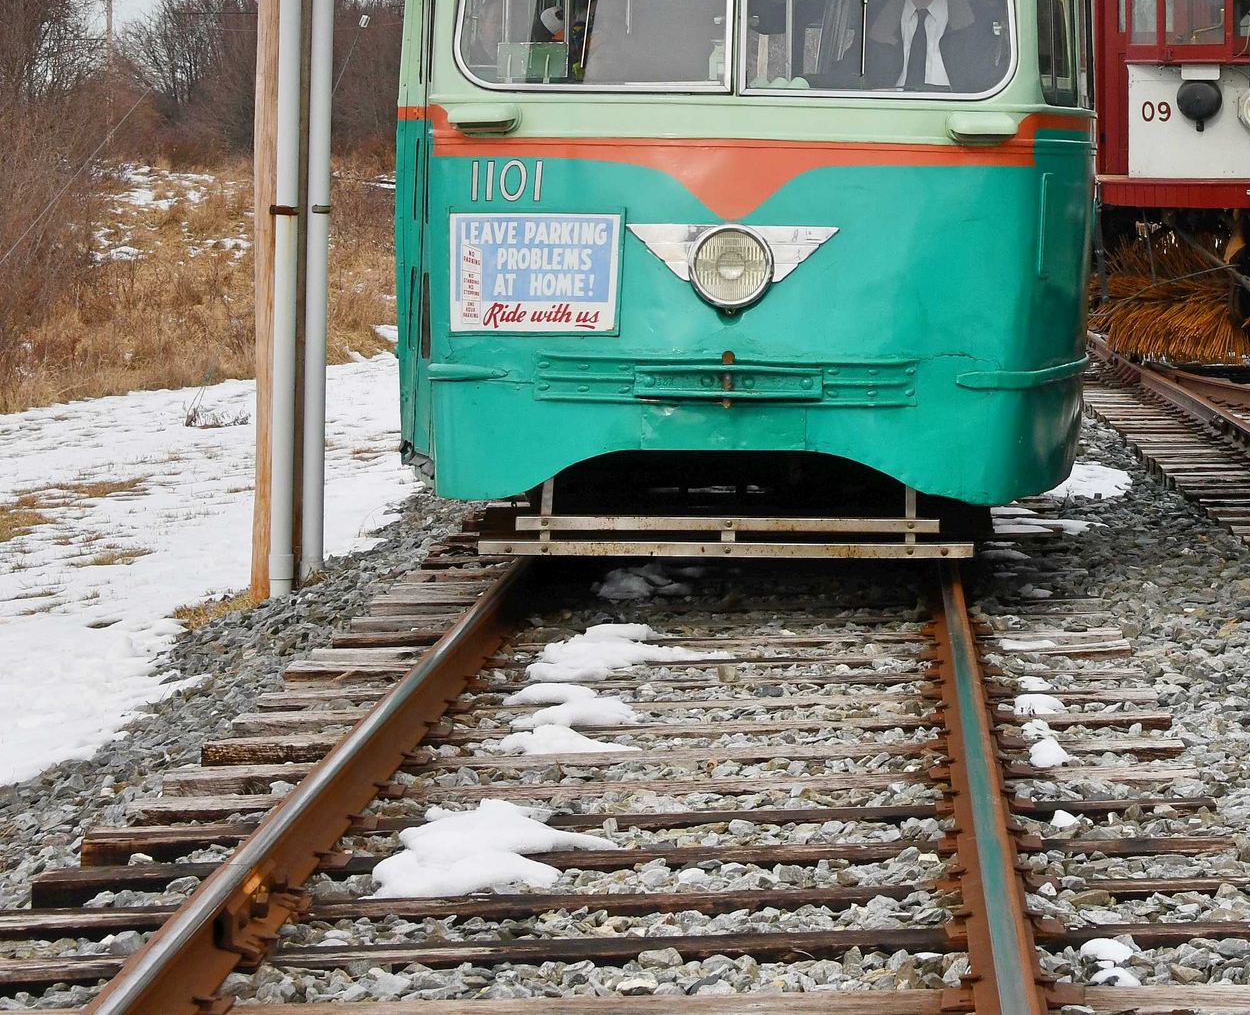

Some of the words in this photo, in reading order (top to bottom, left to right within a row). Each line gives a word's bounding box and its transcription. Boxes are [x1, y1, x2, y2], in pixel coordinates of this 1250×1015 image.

[1142, 101, 1171, 122] 09
[471, 159, 543, 202] 1101
[460, 220, 518, 245] LEAVE
[524, 221, 607, 246] PARKING
[496, 247, 593, 271] PROBLEMS
[493, 273, 517, 297] AT
[483, 302, 527, 329] Ride
[530, 302, 572, 323] with
[575, 309, 600, 325] us
